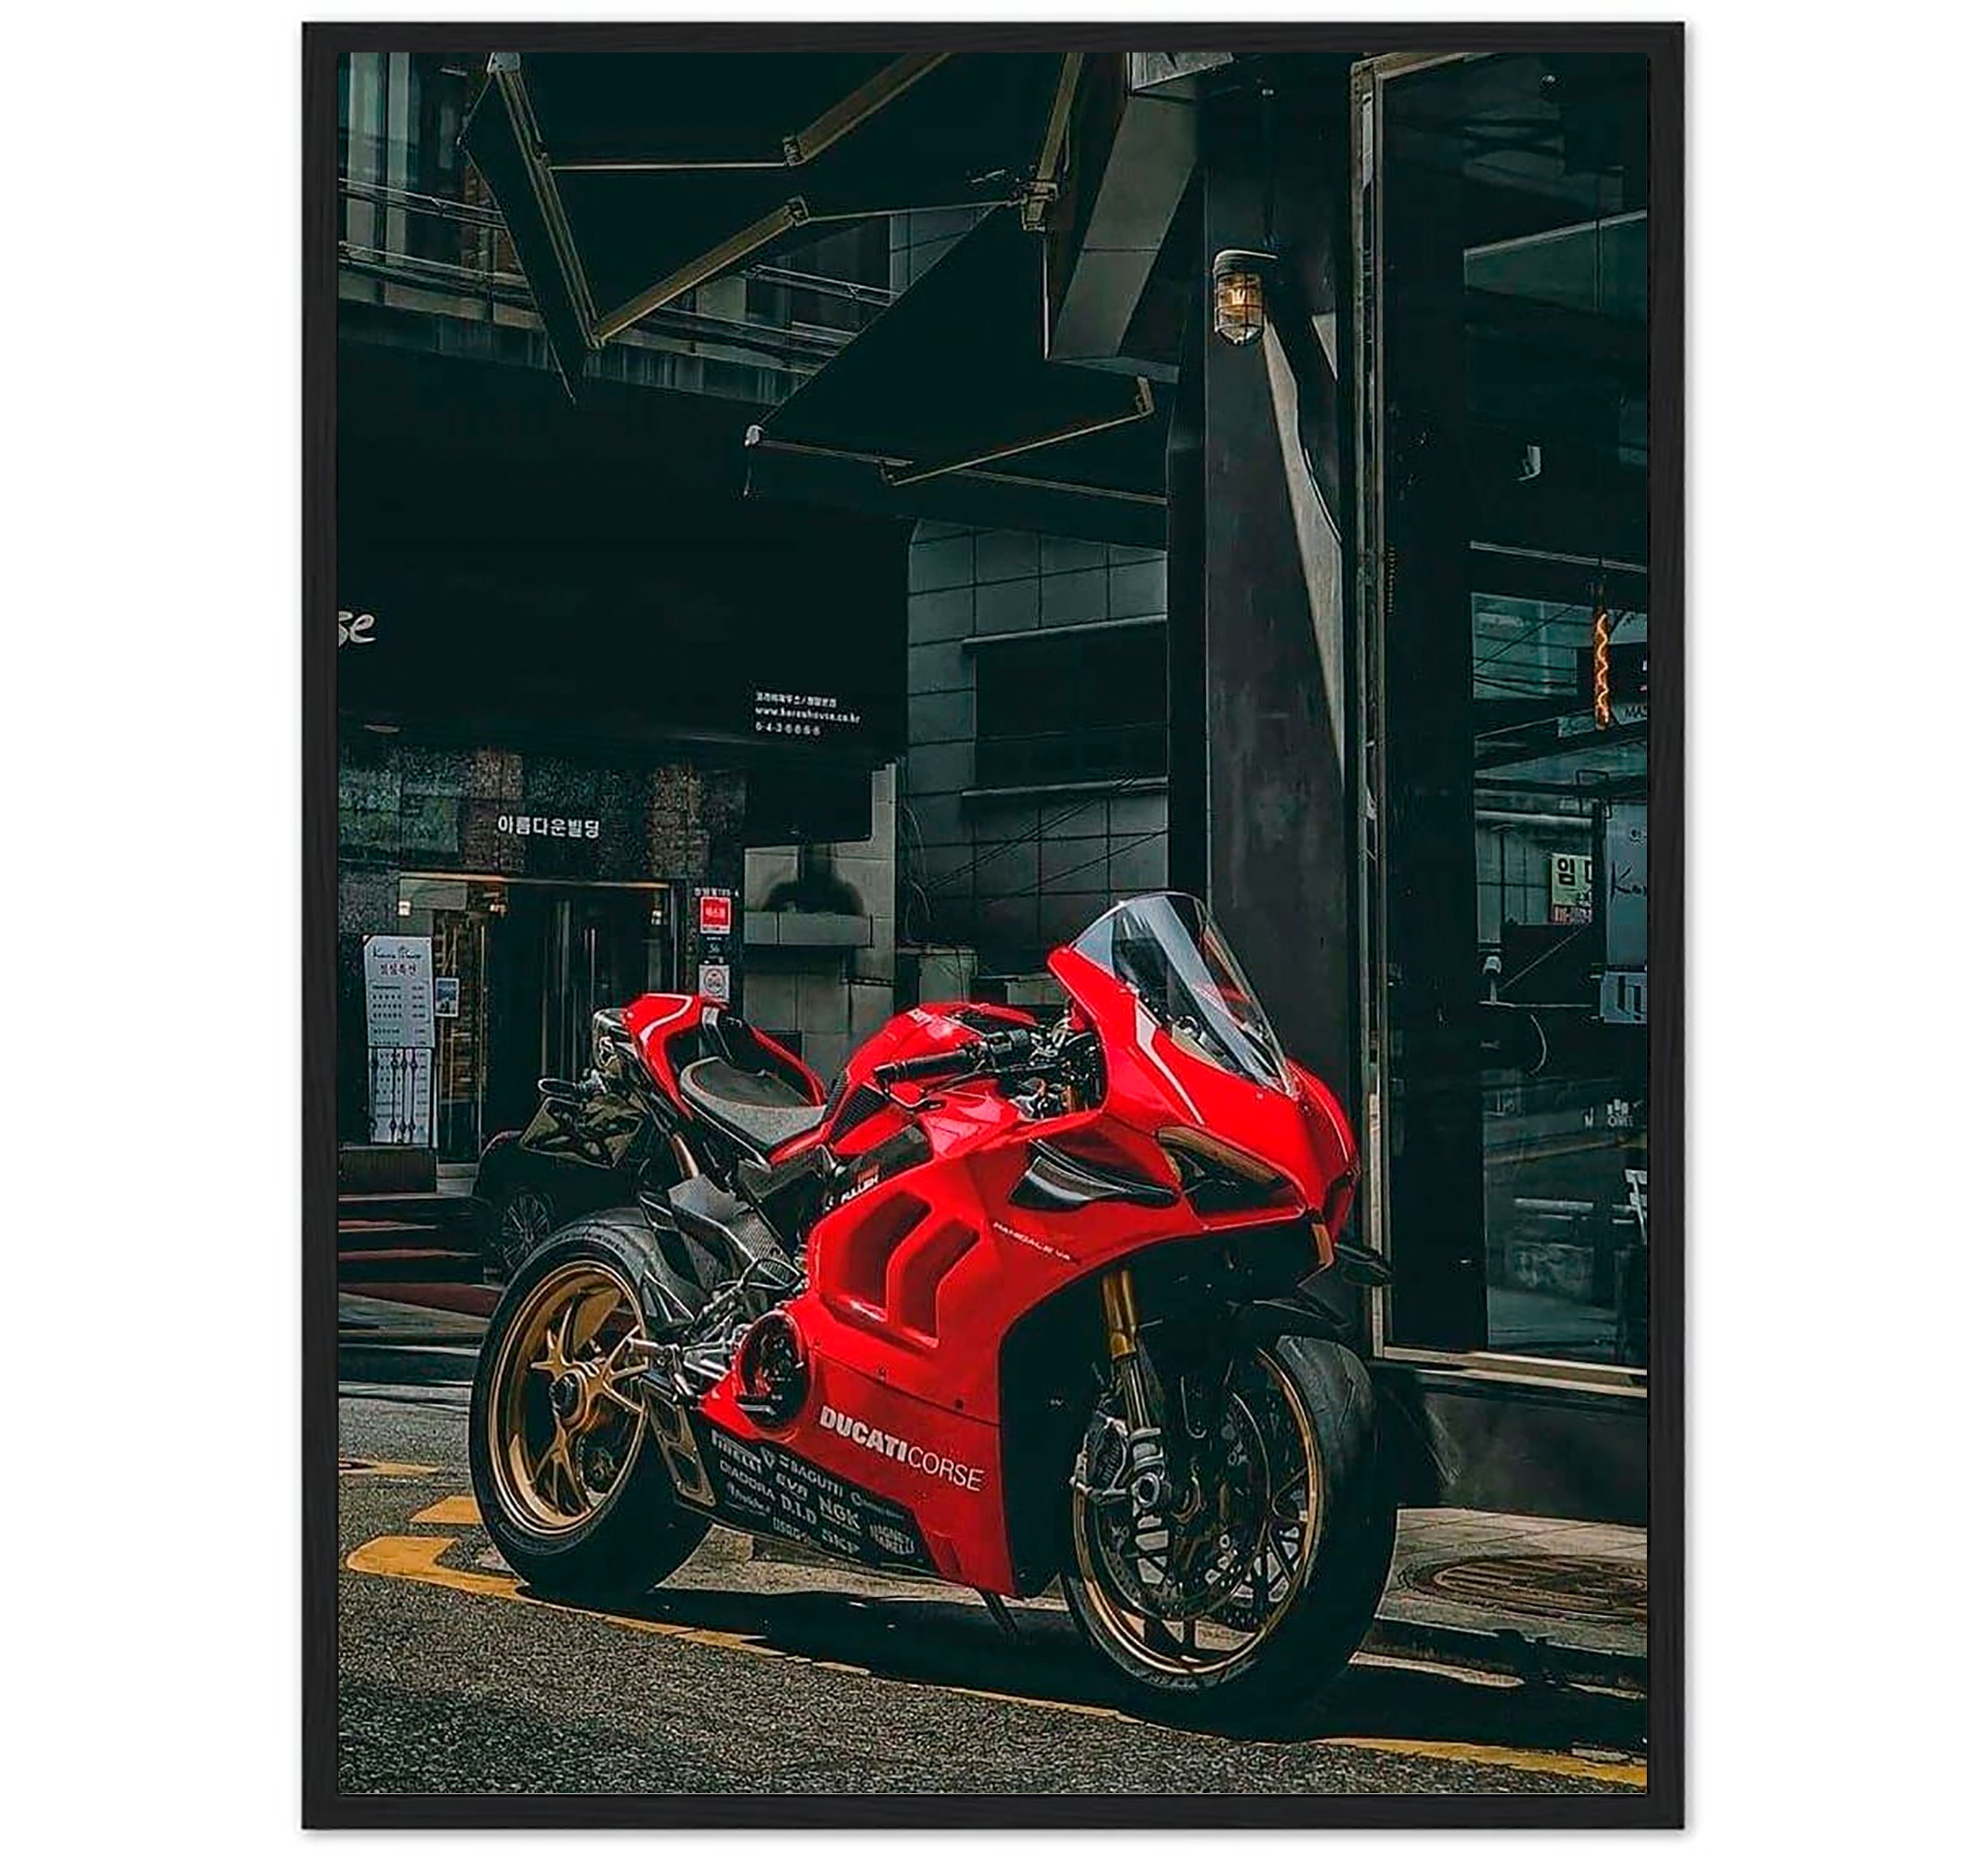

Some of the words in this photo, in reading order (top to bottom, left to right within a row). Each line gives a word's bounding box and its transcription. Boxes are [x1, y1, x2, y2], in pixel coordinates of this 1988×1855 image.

[498, 815, 599, 839] 아름다운빌딩
[819, 1405, 907, 1463] DUCATI
[908, 1446, 985, 1492] CORSE
[819, 1494, 860, 1530] NGK
